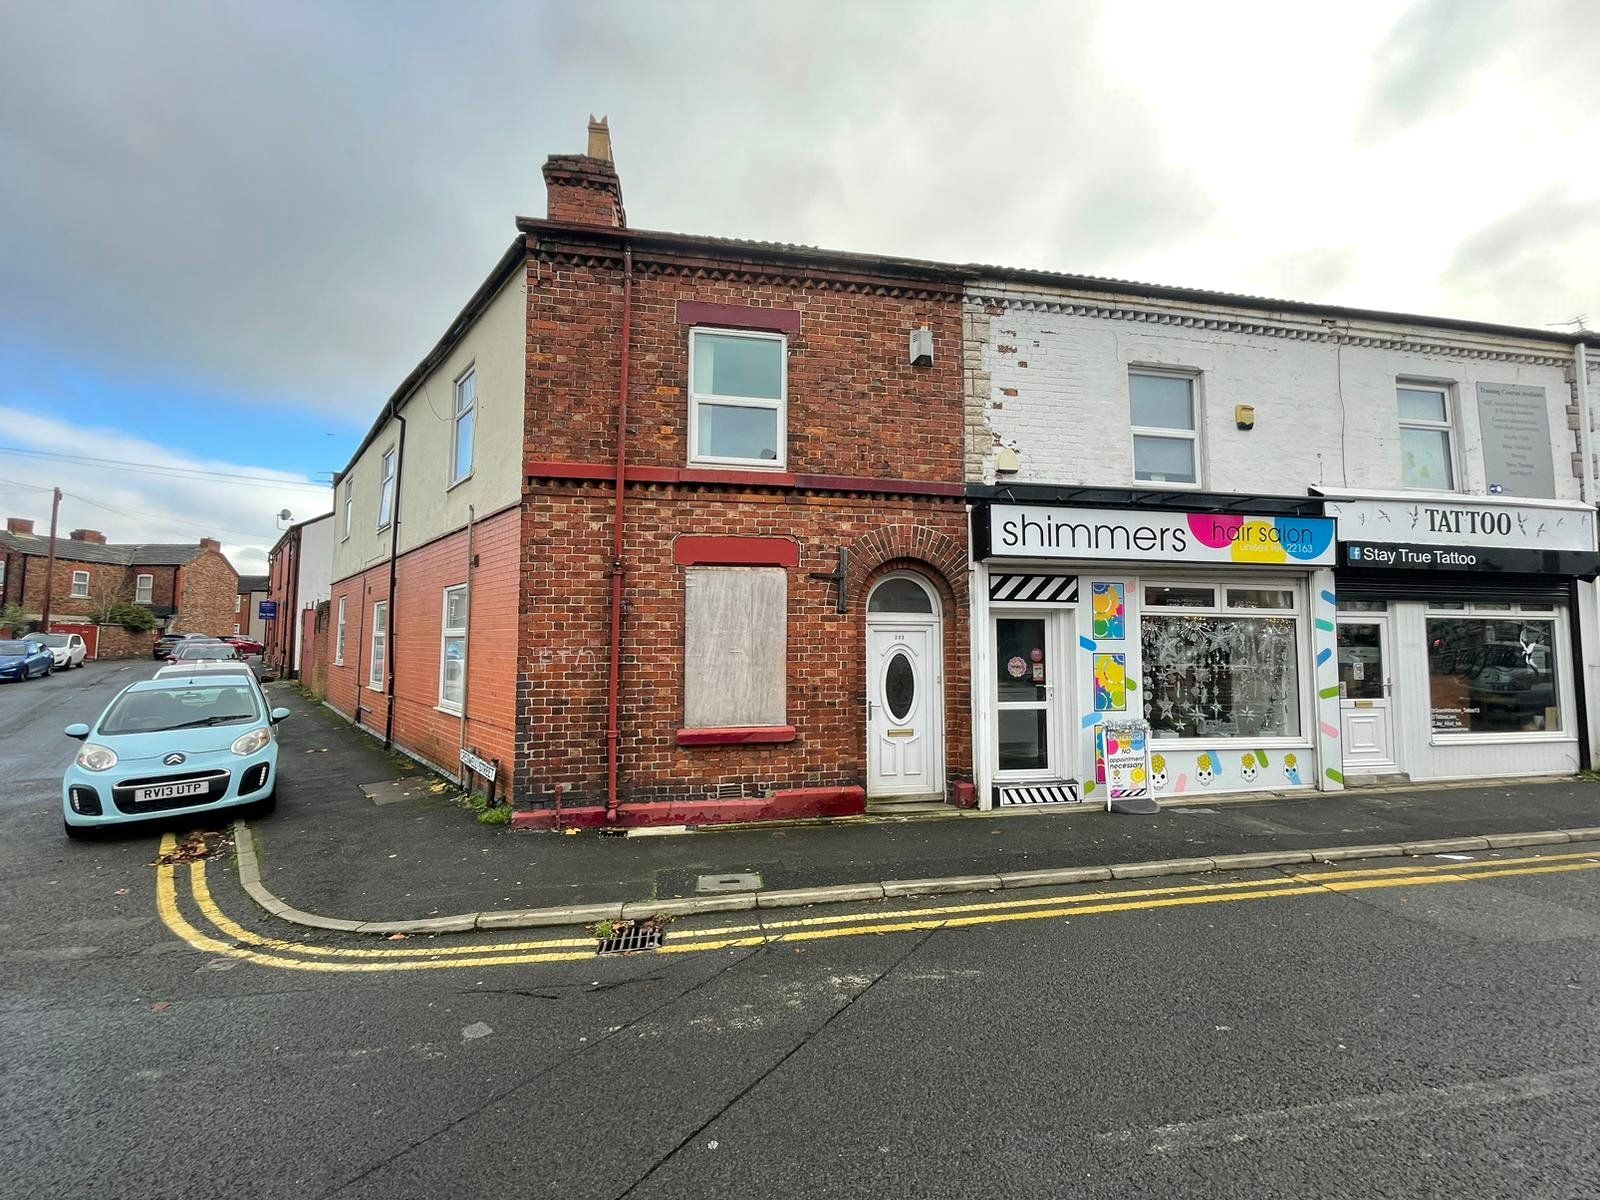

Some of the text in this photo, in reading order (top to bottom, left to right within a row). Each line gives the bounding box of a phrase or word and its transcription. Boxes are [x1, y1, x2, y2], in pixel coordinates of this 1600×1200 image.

[1425, 508, 1512, 535] TATTOO
[1002, 514, 1313, 553] shimmers hair salon
[1286, 543, 1313, 553] 22163
[1363, 547, 1477, 565] Stay True Tattoo
[1110, 756, 1145, 764] appointment
[144, 784, 201, 799] RV13 UTP
